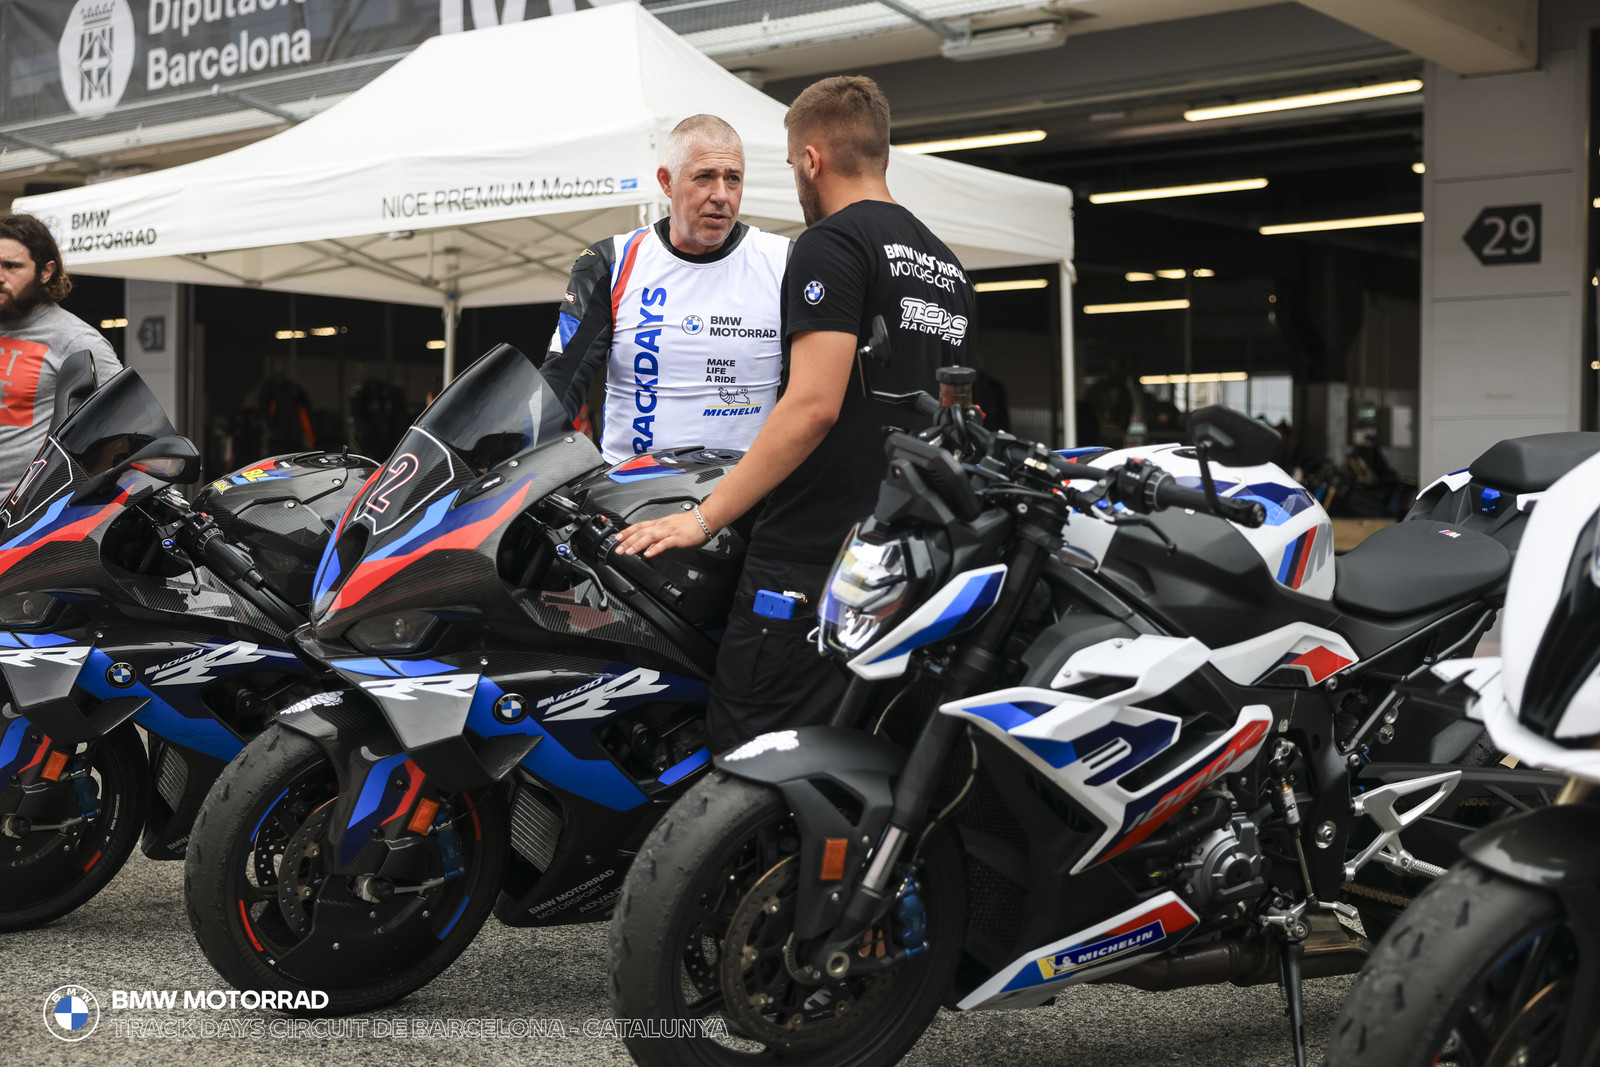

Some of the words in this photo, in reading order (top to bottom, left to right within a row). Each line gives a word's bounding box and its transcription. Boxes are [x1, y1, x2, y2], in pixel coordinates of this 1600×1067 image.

[147, 28, 311, 91] Barcelona
[382, 191, 429, 219] NICE
[434, 181, 535, 214] PREMIUM
[540, 177, 614, 201] Motors
[71, 209, 110, 230] BMW
[68, 228, 157, 252] MOTORRAD
[1482, 214, 1536, 256] 29
[883, 243, 914, 260] BMW
[889, 260, 956, 294] MOTORSORT
[143, 321, 162, 348] 31
[709, 327, 777, 339] MOTORRAD
[710, 315, 742, 327] BMW
[632, 287, 667, 454] RACKDAYS
[706, 366, 726, 375] LIFE
[707, 358, 736, 367] MAKE
[705, 374, 713, 383] A
[714, 375, 737, 383] RIDE
[702, 405, 762, 417] MICHELIN
[366, 452, 420, 514] 2
[528, 898, 557, 915] BMW
[556, 869, 615, 903] MOTORRAD
[536, 884, 603, 920] MOTORSPORT
[1078, 930, 1153, 963] MICHELIN
